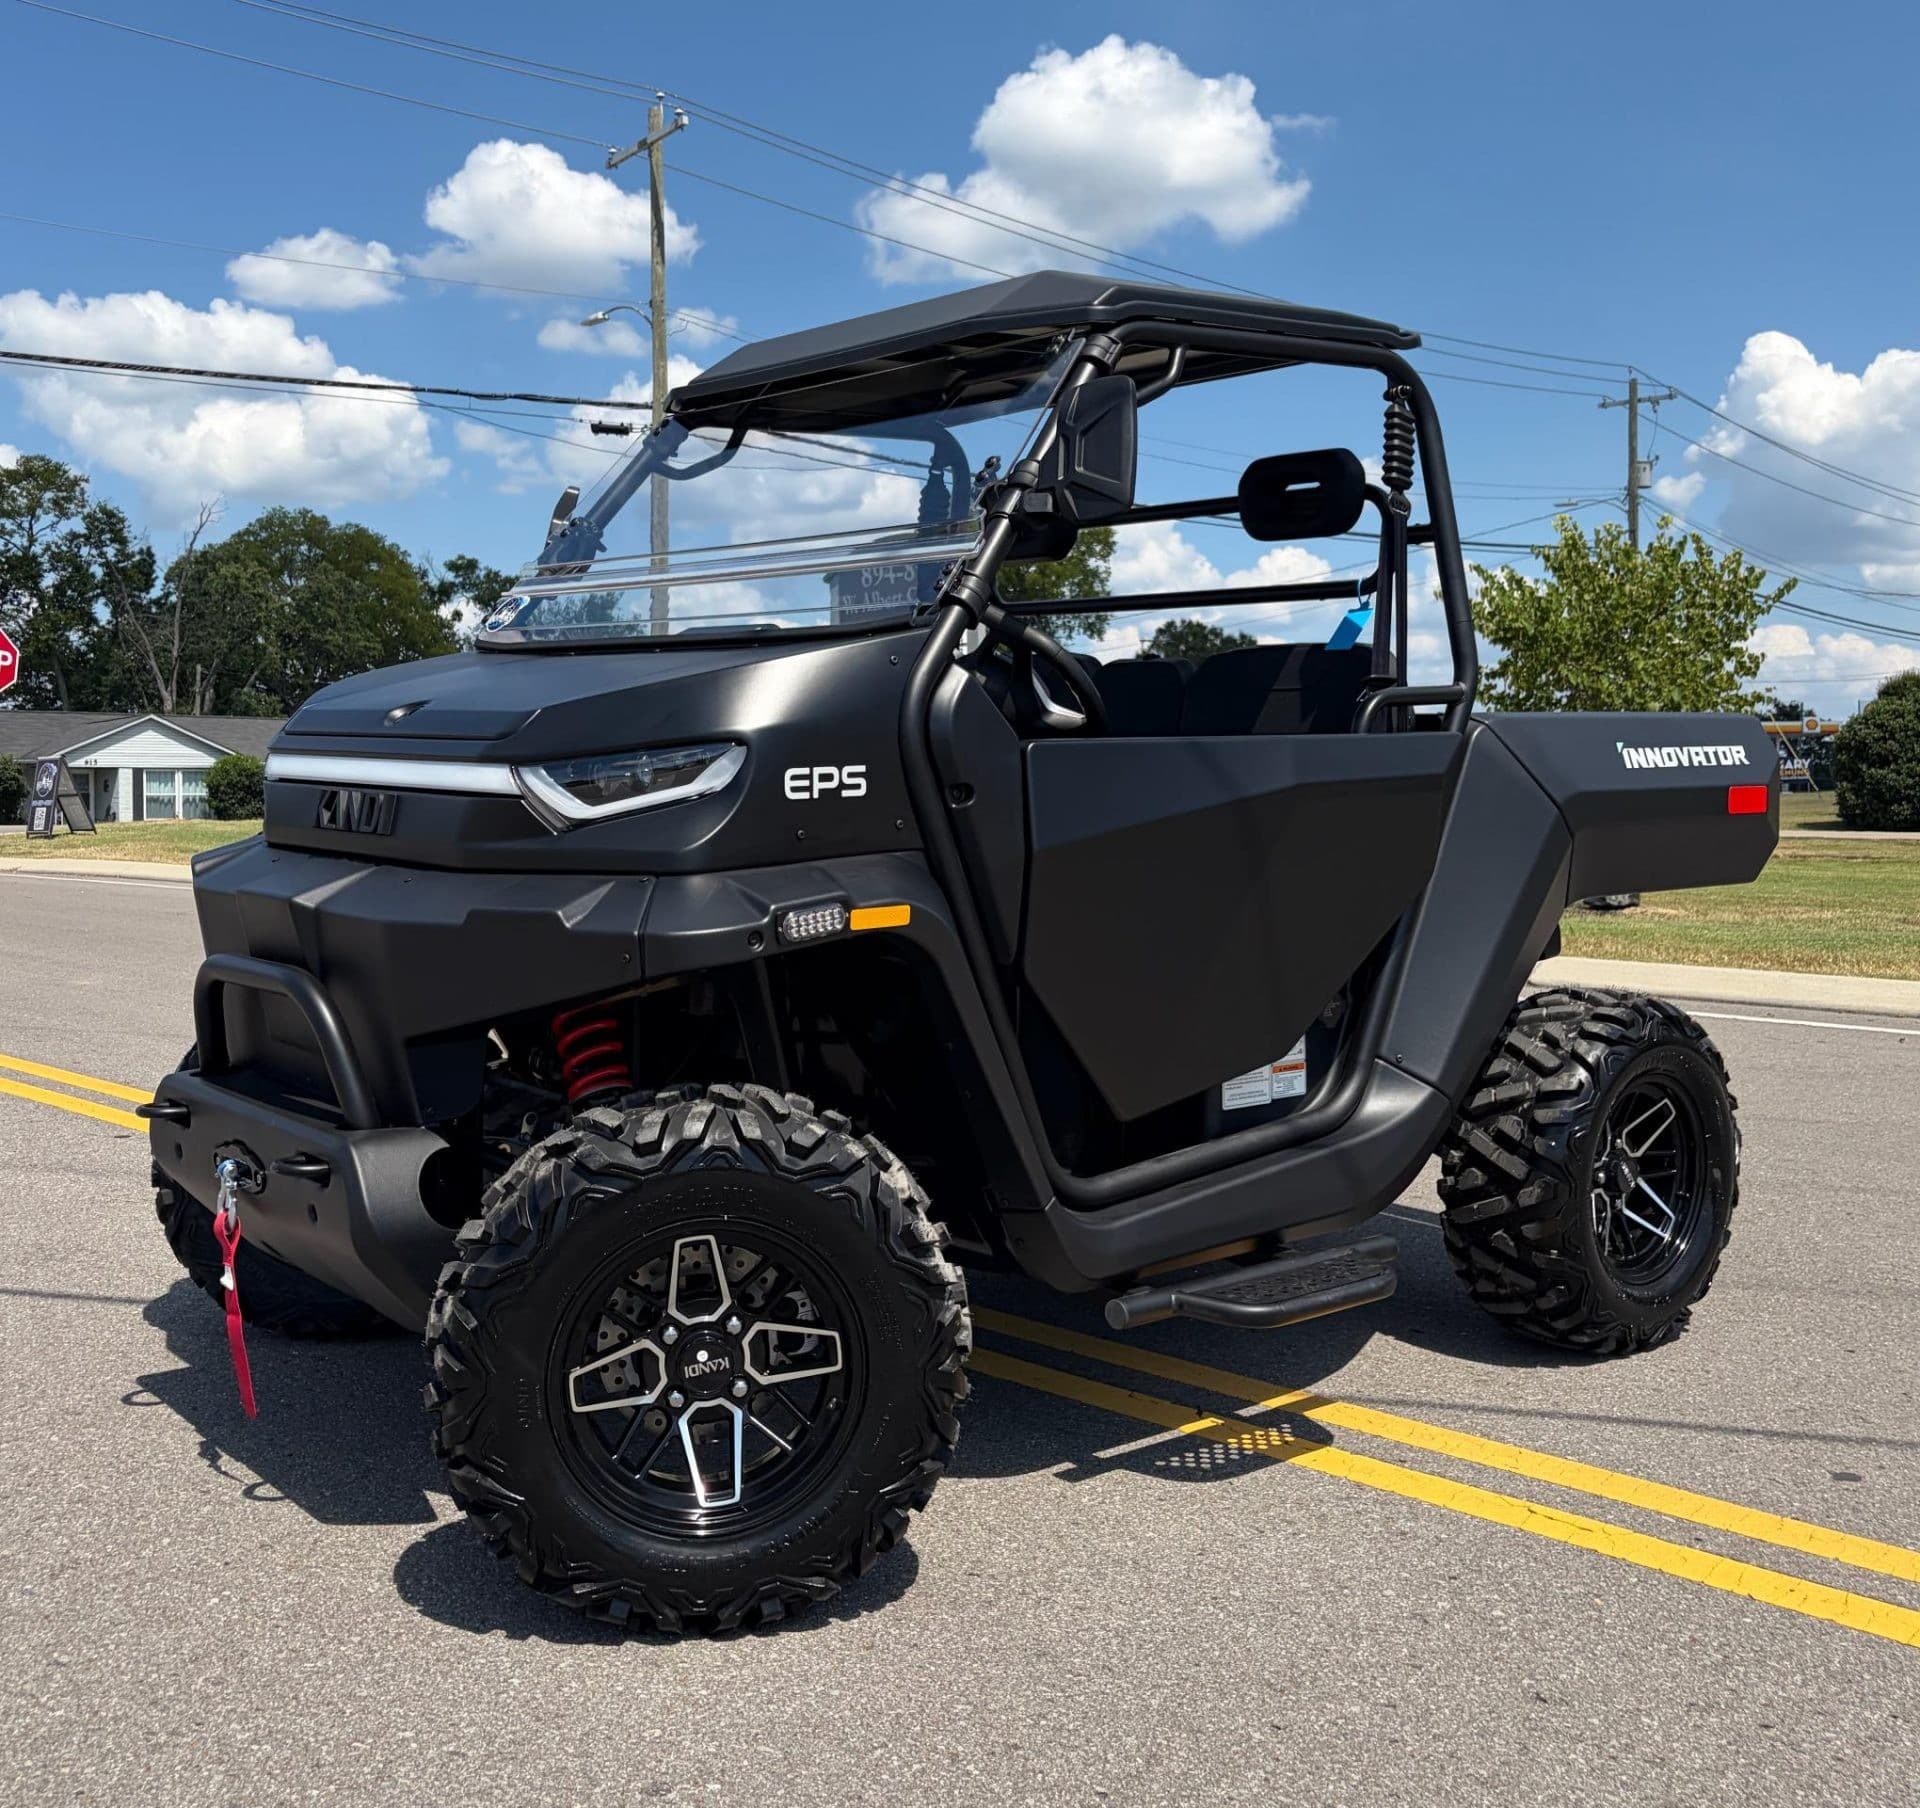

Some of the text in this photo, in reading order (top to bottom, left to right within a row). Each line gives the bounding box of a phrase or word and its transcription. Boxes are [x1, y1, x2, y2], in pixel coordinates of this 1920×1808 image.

[1616, 742, 1750, 769] INNOVATOR
[784, 765, 867, 800] EPS
[684, 1356, 730, 1379] KANDI
